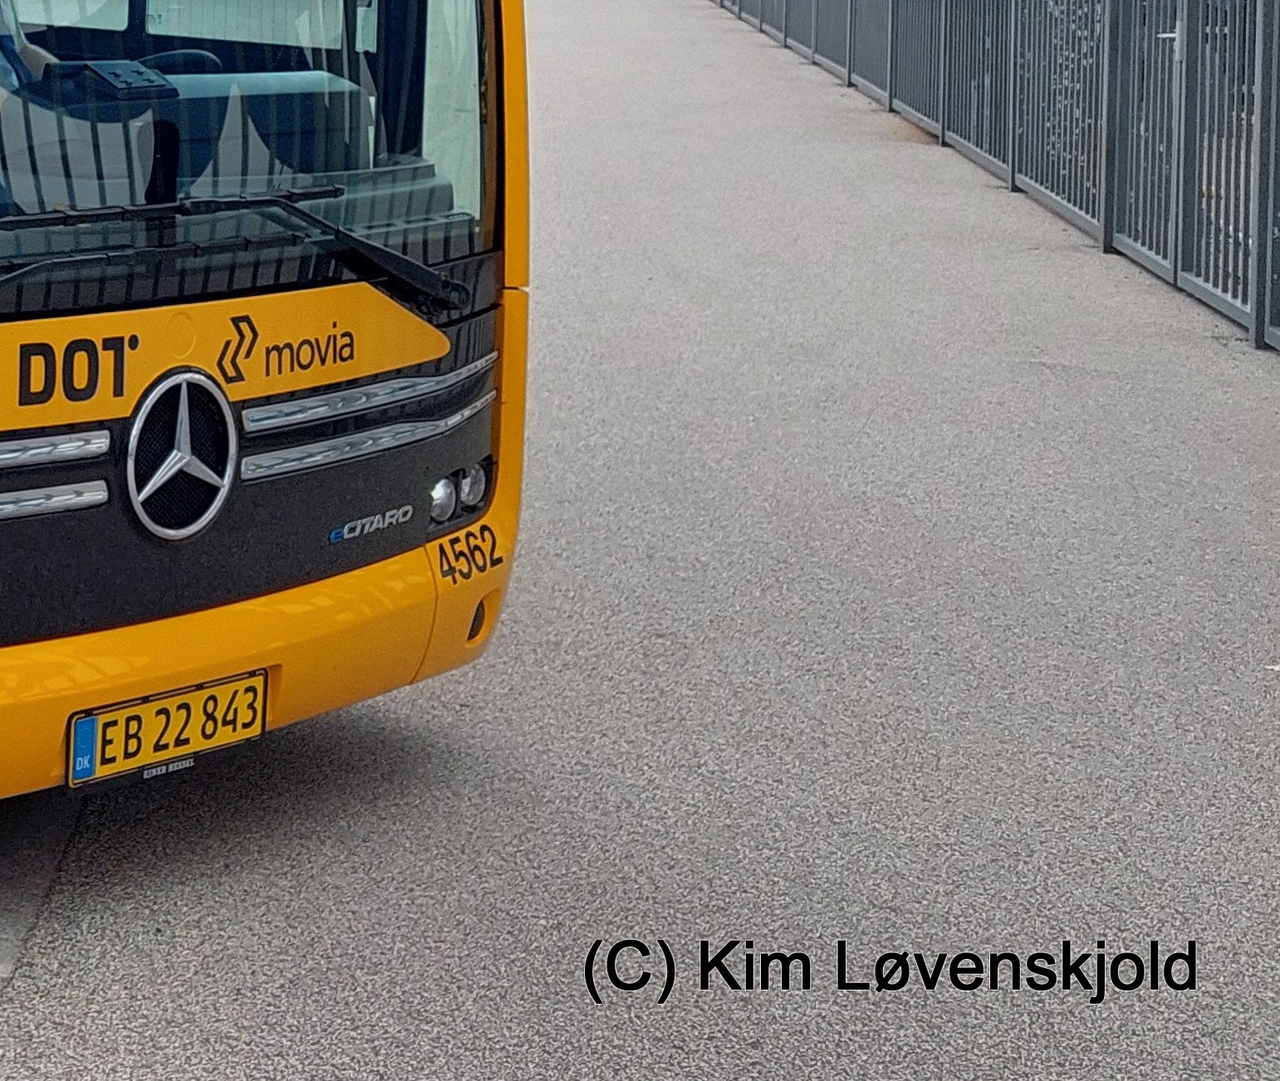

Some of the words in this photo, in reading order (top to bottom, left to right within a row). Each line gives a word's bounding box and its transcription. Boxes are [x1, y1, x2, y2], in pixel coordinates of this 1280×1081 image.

[264, 320, 356, 378] movia
[328, 504, 414, 546] eCITARO
[438, 523, 505, 586] 4562
[99, 713, 143, 767] EB
[152, 701, 193, 754] 22
[200, 684, 260, 742] 843
[75, 754, 91, 771] DK
